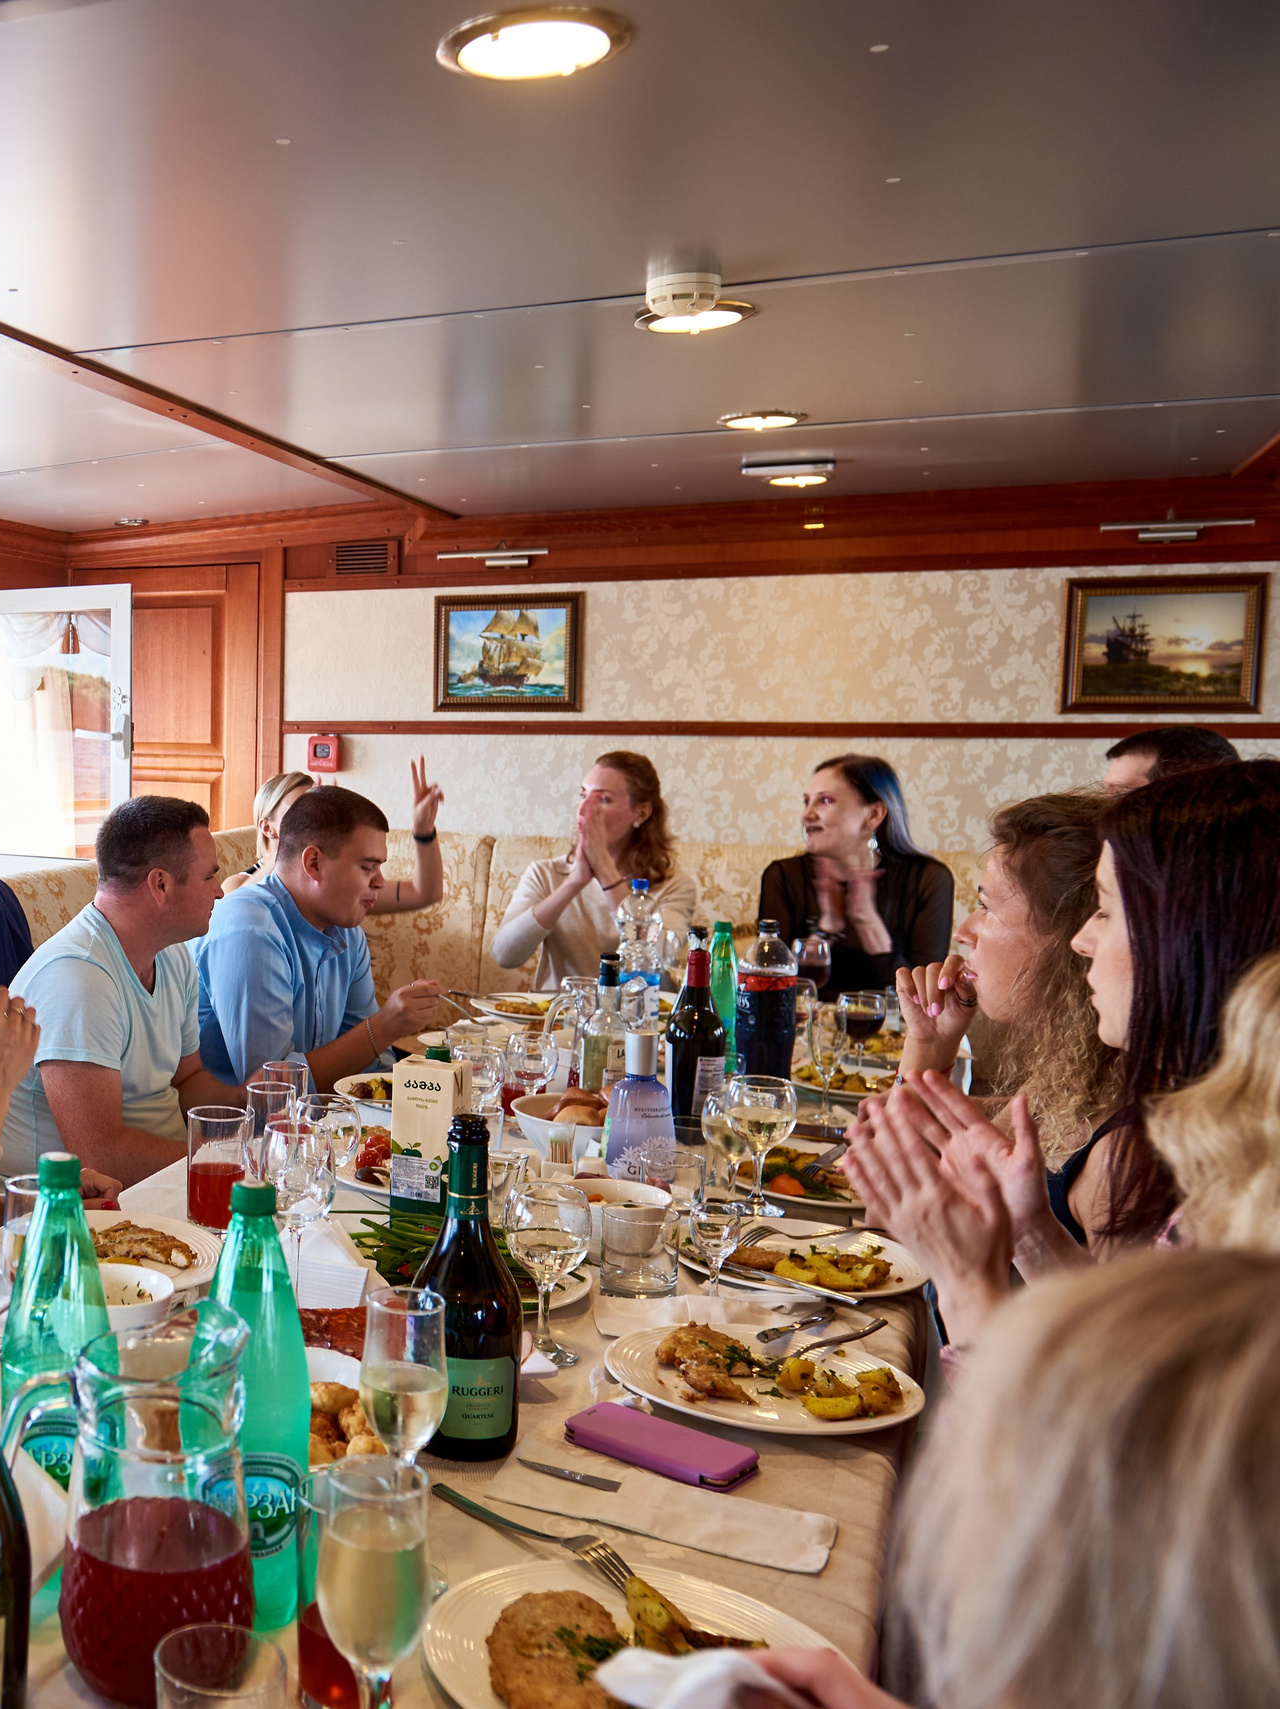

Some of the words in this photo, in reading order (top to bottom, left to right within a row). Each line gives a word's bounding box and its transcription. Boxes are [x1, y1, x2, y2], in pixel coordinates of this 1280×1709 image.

[404, 1079, 441, 1091] კამპა
[452, 1385, 504, 1396] RUGGERI
[250, 1543, 284, 1558] ОВАННАЯ
